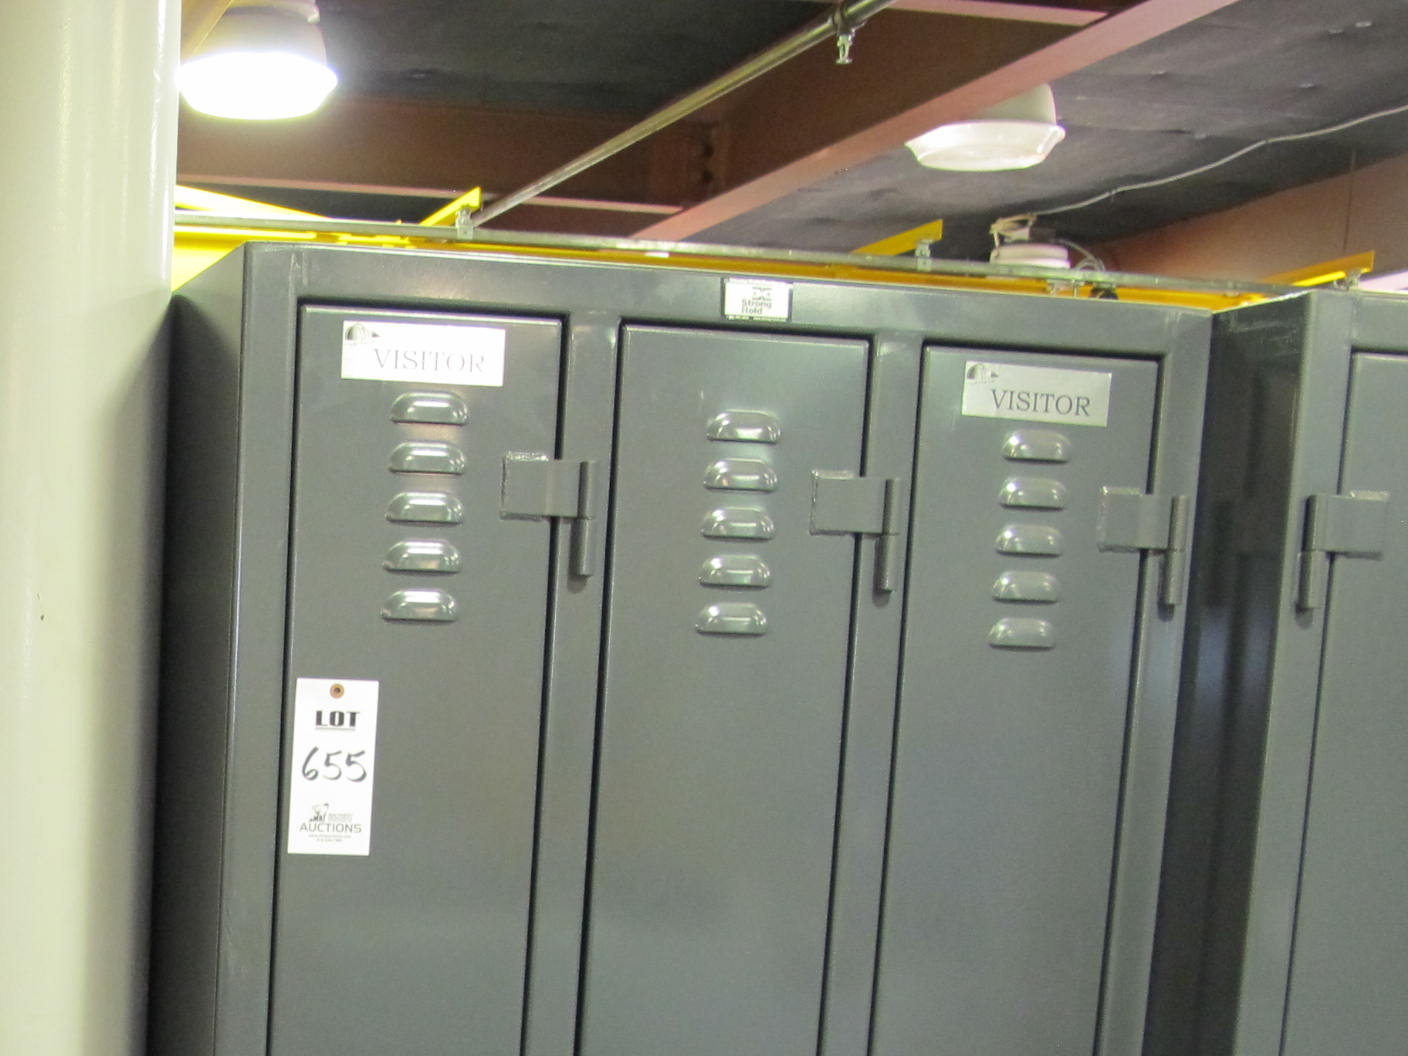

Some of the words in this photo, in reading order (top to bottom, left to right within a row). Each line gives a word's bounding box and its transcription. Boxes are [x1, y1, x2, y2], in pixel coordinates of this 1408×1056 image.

[374, 348, 485, 373] VISITOR
[990, 388, 1091, 417] VISITOR
[315, 710, 360, 728] LOT
[301, 746, 367, 783] 655
[298, 822, 362, 834] AUCTIONS
